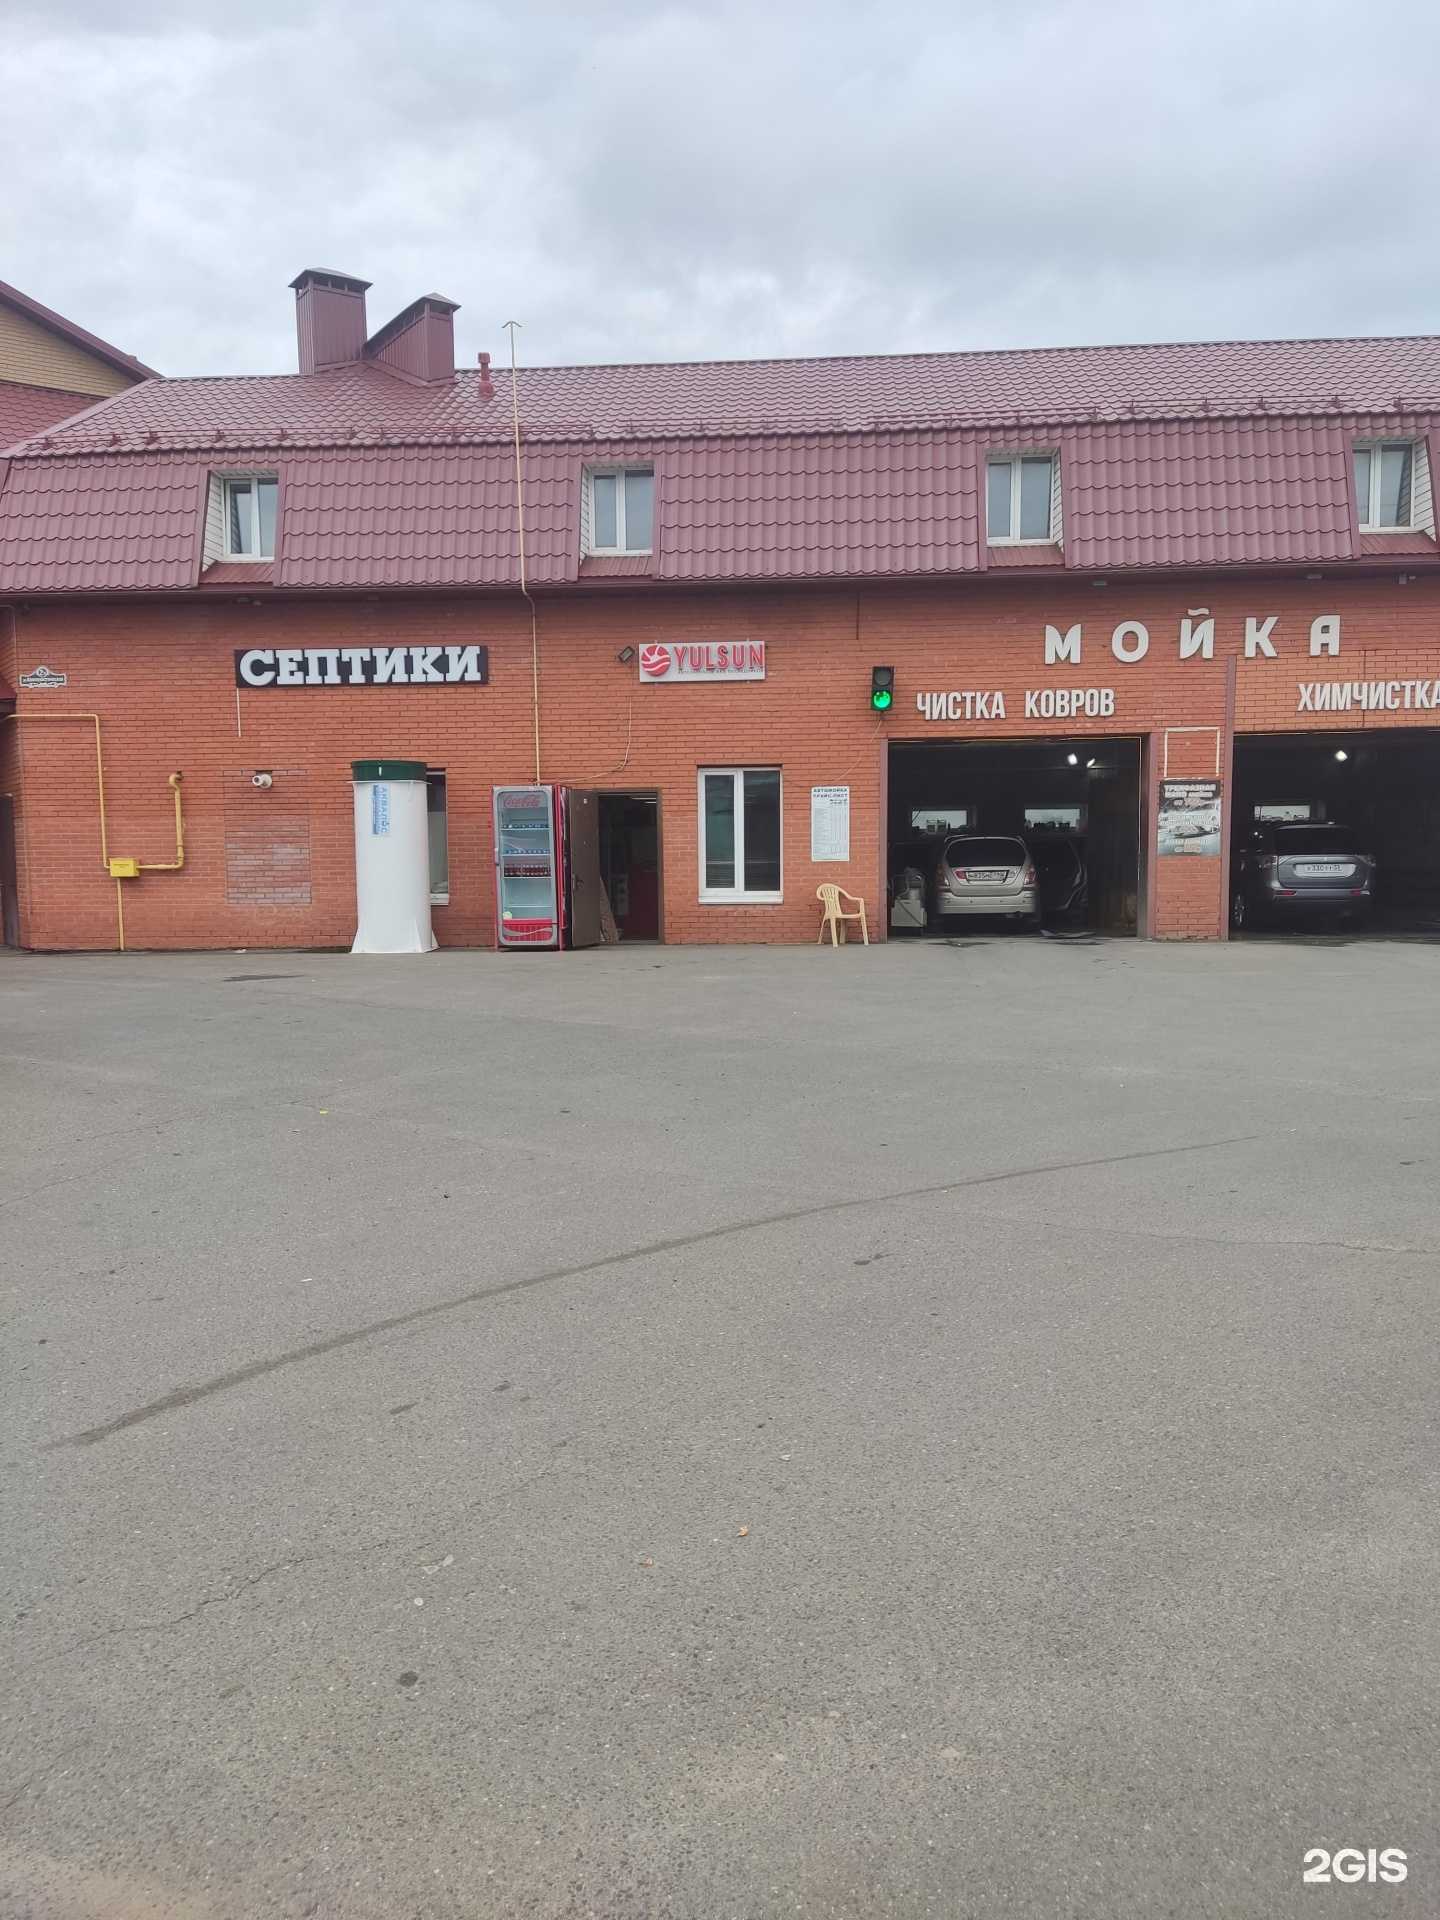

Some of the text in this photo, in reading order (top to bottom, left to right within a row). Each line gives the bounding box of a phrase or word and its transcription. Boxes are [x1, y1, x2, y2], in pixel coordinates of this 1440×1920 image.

[1044, 607, 1340, 665] МОЙКА
[239, 645, 481, 686] СЕПТИКИ
[673, 644, 764, 670] YULSUN
[916, 688, 1115, 721] ЧИСТКА КОВРОВ
[1297, 680, 1440, 711] ХИМЧИСТКА
